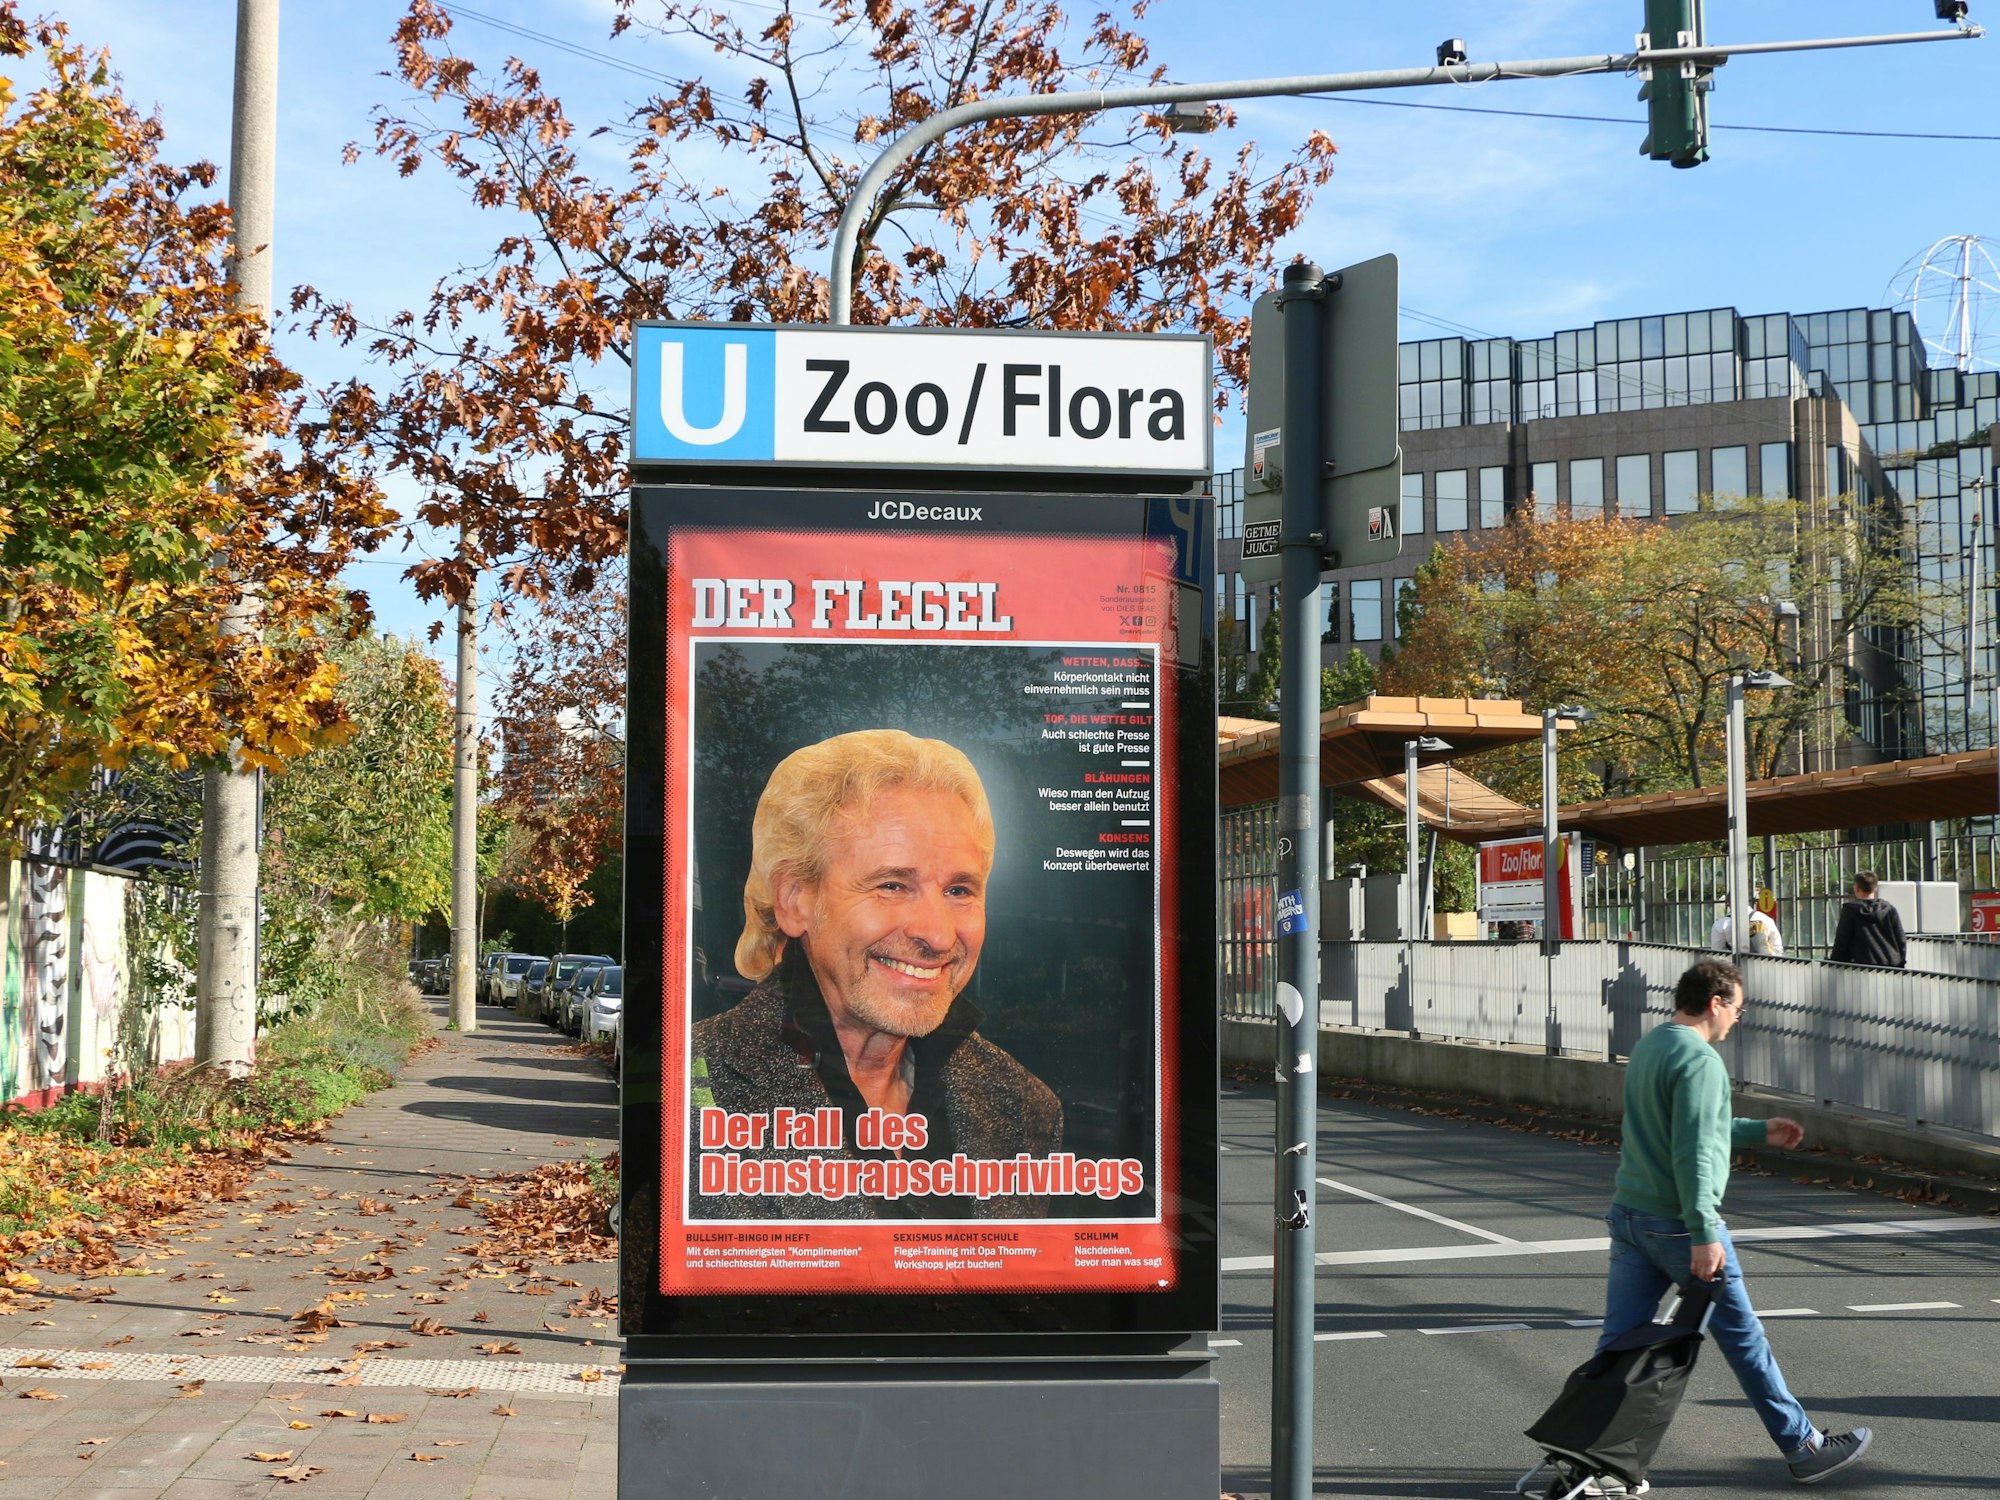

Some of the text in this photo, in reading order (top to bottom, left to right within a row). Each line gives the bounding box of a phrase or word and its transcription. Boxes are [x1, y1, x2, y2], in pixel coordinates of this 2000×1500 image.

[660, 341, 1186, 446] U Zoo/Flora
[867, 501, 983, 521] JCDecaux
[1117, 585, 1156, 594] Nr. 0815
[691, 578, 1013, 631] DER FLEGEL
[1062, 657, 1150, 668] WETTEN, DASS...
[1053, 671, 1150, 683] Körperkontakt nicht
[1024, 684, 1150, 696] einvernehmlich sein muss
[1043, 714, 1153, 725] TOP, DIE WETTE GILT
[1041, 729, 1150, 740] Auch schlechte Presse
[1078, 742, 1150, 755] ist gute Presse
[1084, 771, 1150, 783] BLÄHUNGEN
[1038, 787, 1150, 801] Wieso man den Aufzug
[1049, 801, 1150, 812] besser allein benutzt
[1098, 833, 1150, 843] KONSENS
[1056, 847, 1150, 860] Deswegen wird das
[1043, 860, 1150, 872] Konzept überbewertet
[1501, 848, 1543, 878] Zoo/Flor
[700, 1107, 929, 1151] Der Fall des
[699, 1153, 1144, 1201] Dienstgrapschprivilegs
[686, 1233, 810, 1242] BULLSHIT-BINGO IM HEFT
[893, 1233, 1020, 1242] SEXISMUS MACHT SCHULE
[1074, 1232, 1119, 1241] SCHLIMM
[686, 1246, 862, 1259] Mit den schmierigsten "Komplimenten"
[894, 1246, 958, 1258] Flegel-Training
[960, 1246, 976, 1256] mit
[977, 1246, 996, 1257] Opa
[998, 1245, 1037, 1258] Thommy
[1074, 1245, 1133, 1256] Nachdenken,
[686, 1258, 840, 1268] und schlechtesten Altherrenwitzen
[894, 1259, 1003, 1271] Workshops jetzt buchen!
[1074, 1257, 1163, 1268] bevor man was sagt
